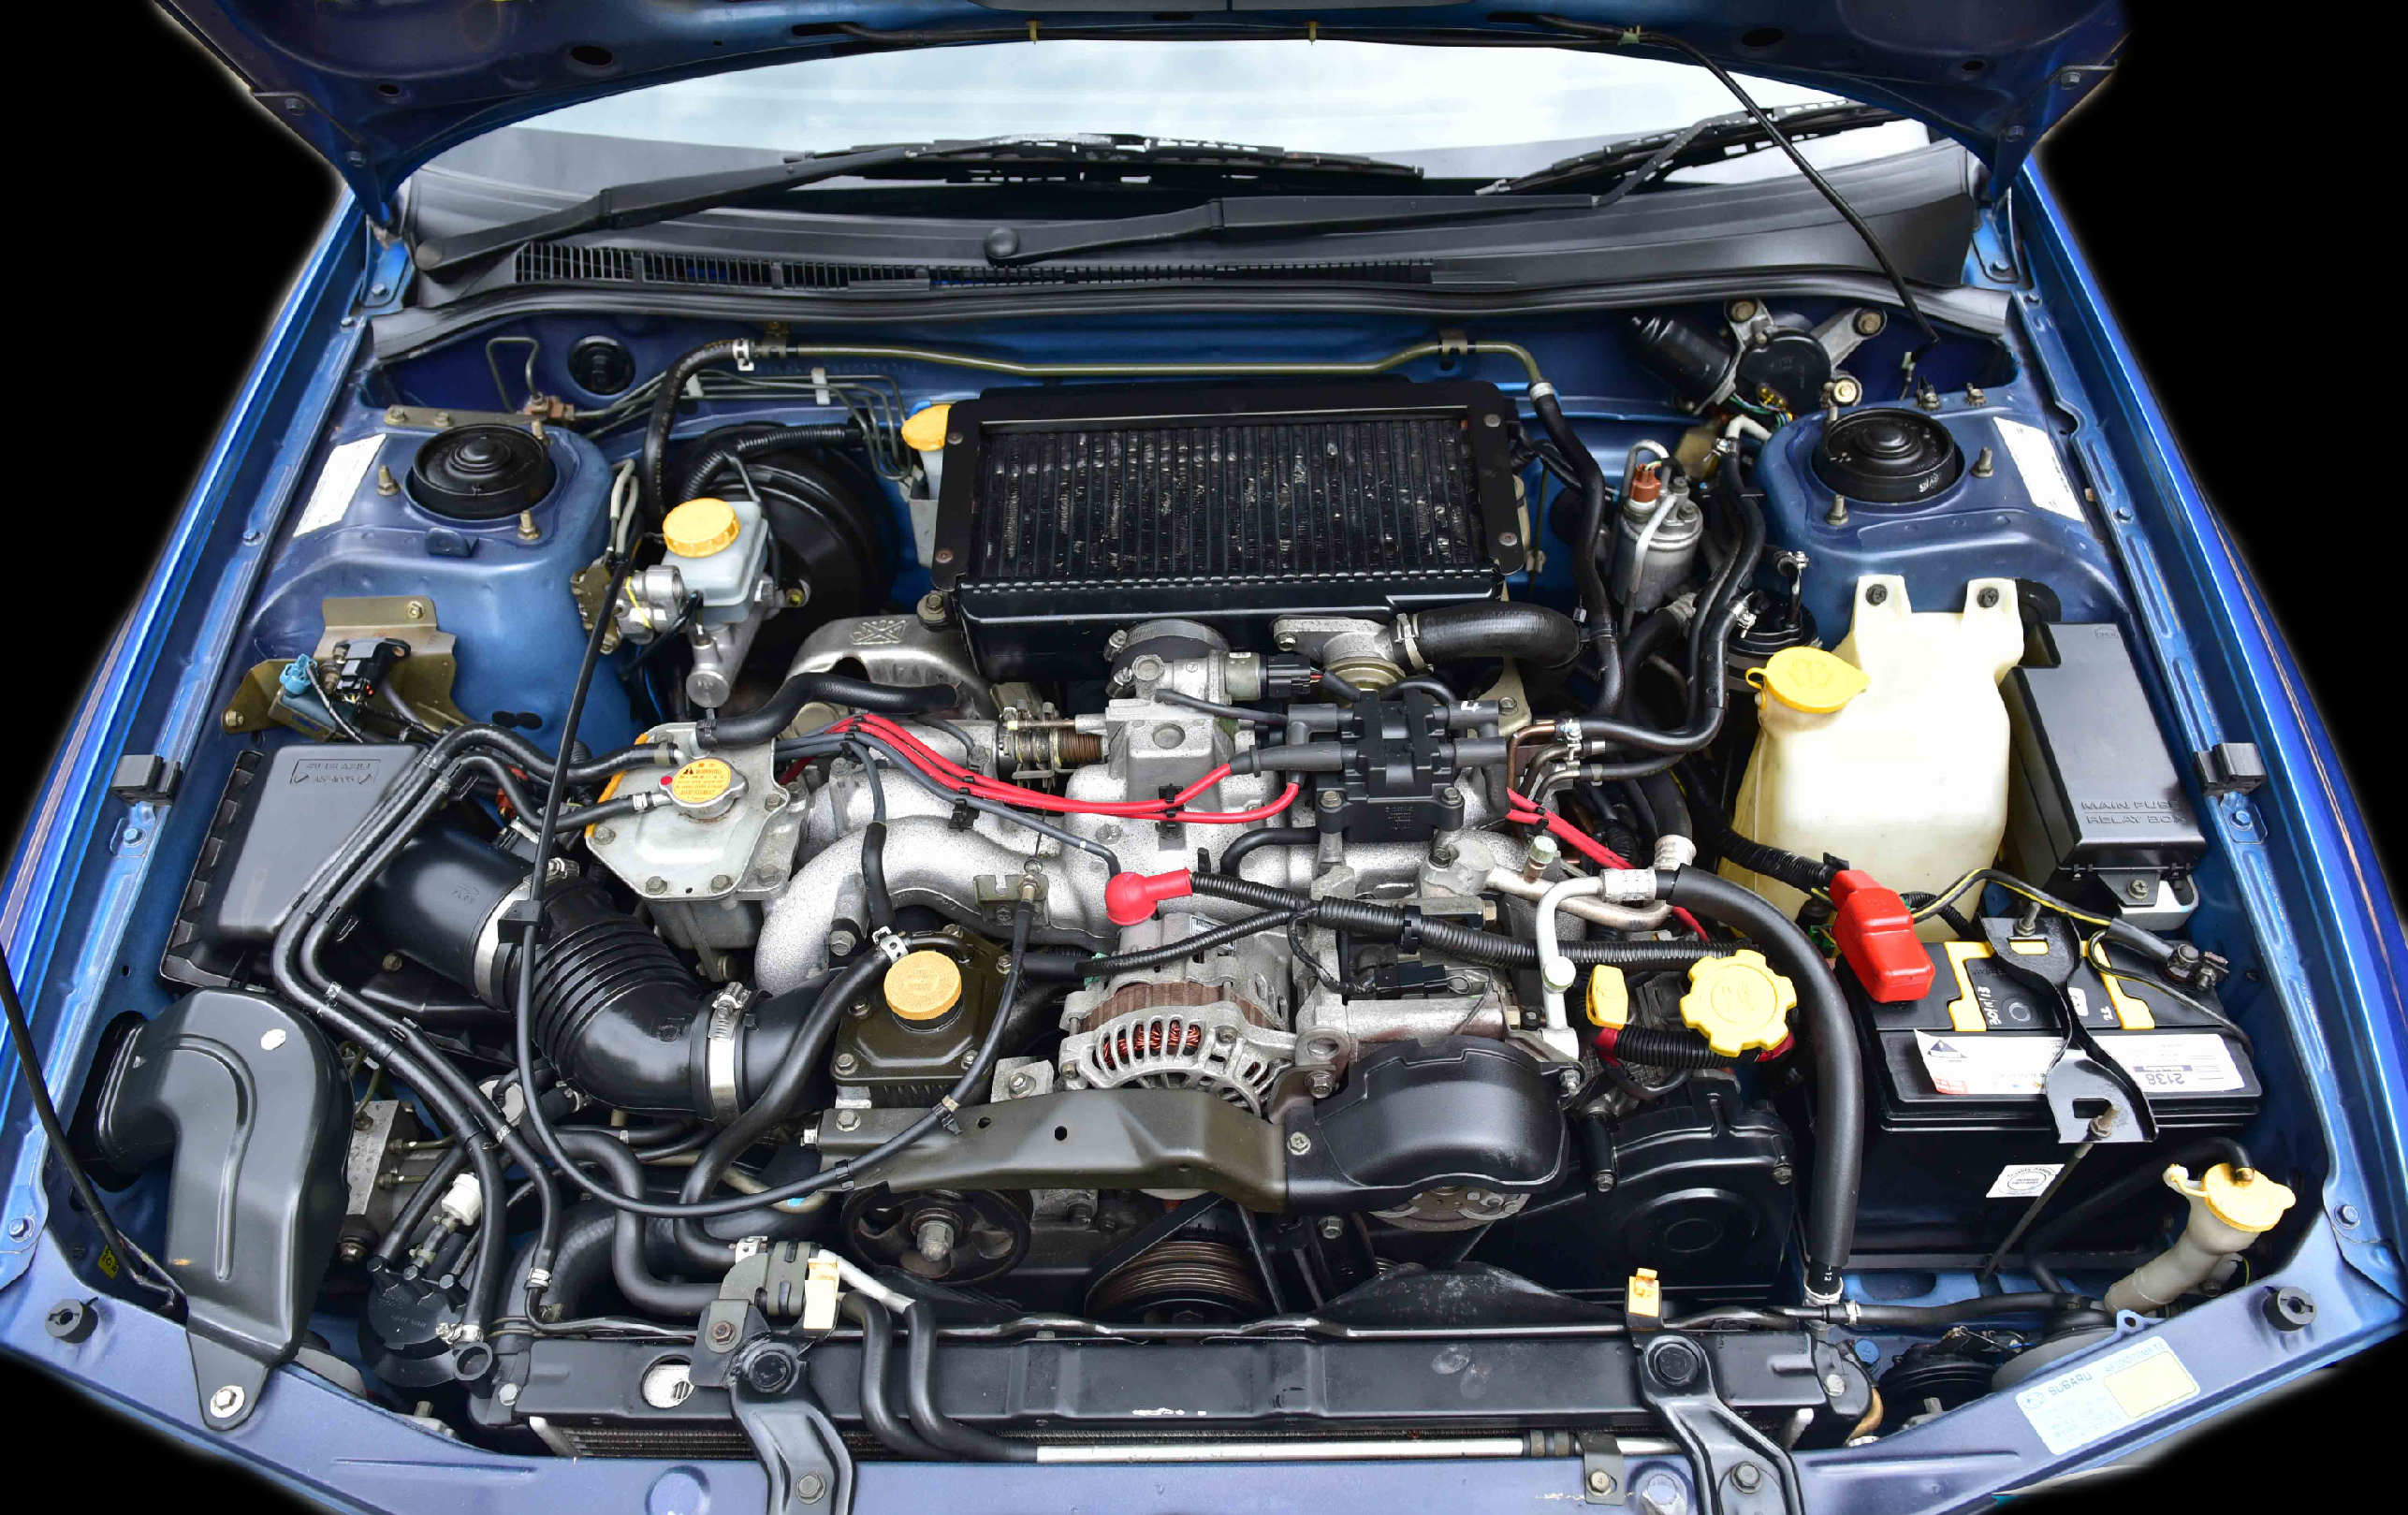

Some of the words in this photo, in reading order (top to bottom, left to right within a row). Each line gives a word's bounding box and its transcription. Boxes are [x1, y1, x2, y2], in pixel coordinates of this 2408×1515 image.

[2080, 801, 2130, 810] MAIN
[2133, 801, 2181, 810] FUSE
[2086, 815, 2142, 824] RELAY
[2148, 815, 2186, 824] BOX
[1977, 985, 2002, 1026] 30/11/13
[2145, 1073, 2185, 1085] 2138
[2048, 1371, 2093, 1396] SUBARU
